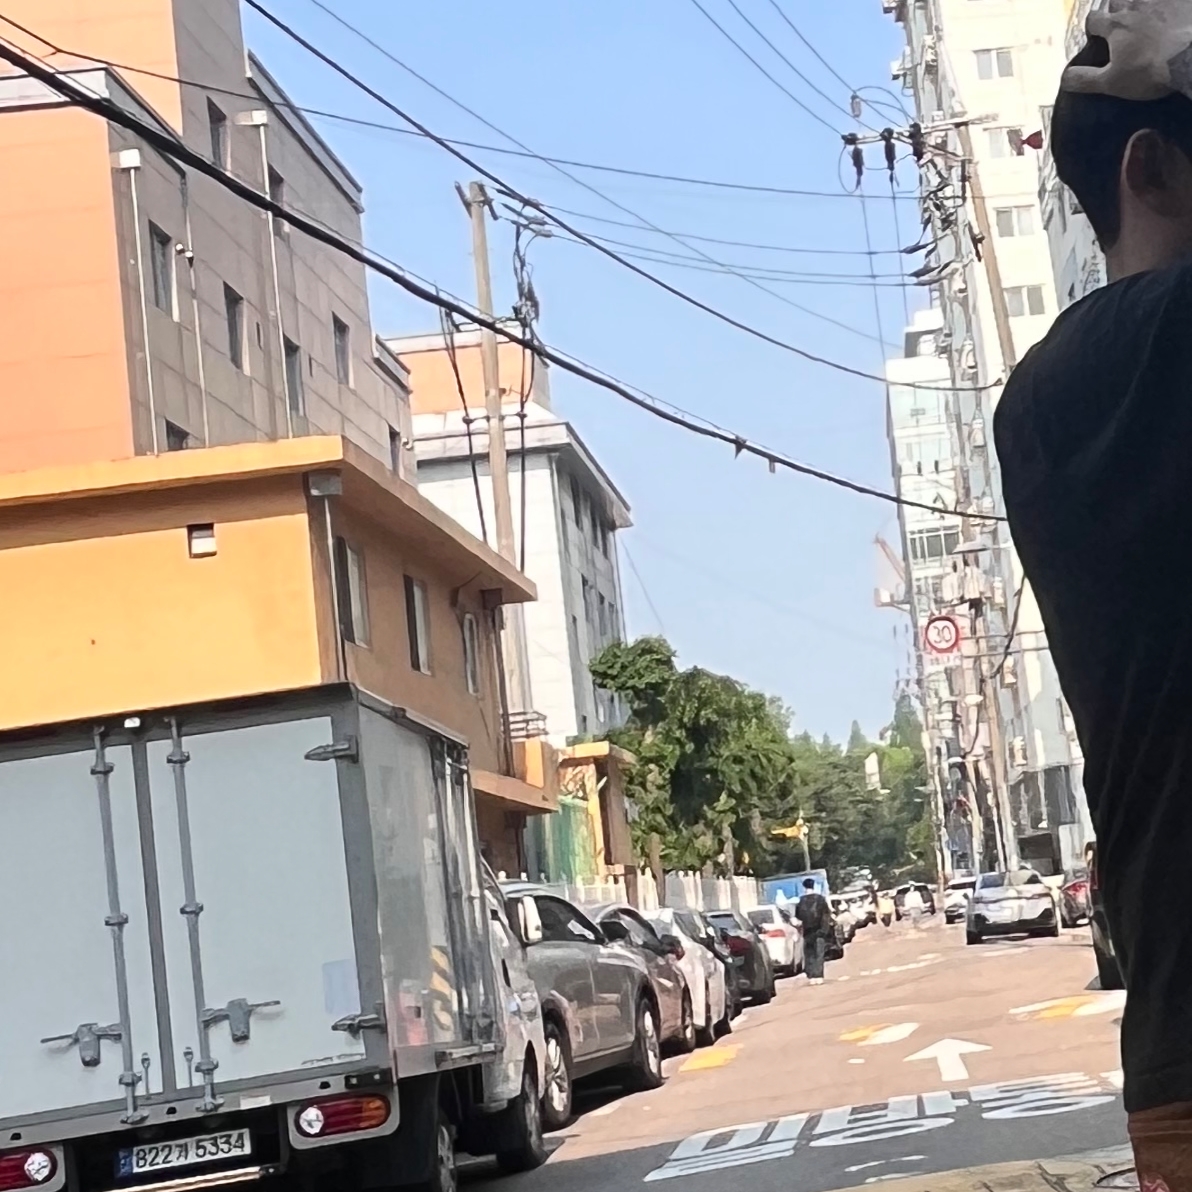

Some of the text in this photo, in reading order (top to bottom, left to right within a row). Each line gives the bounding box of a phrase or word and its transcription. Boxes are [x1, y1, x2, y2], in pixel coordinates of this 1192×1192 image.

[932, 625, 953, 644] 30
[643, 1070, 1124, 1183] 일방통
[195, 1131, 245, 1158] 5334
